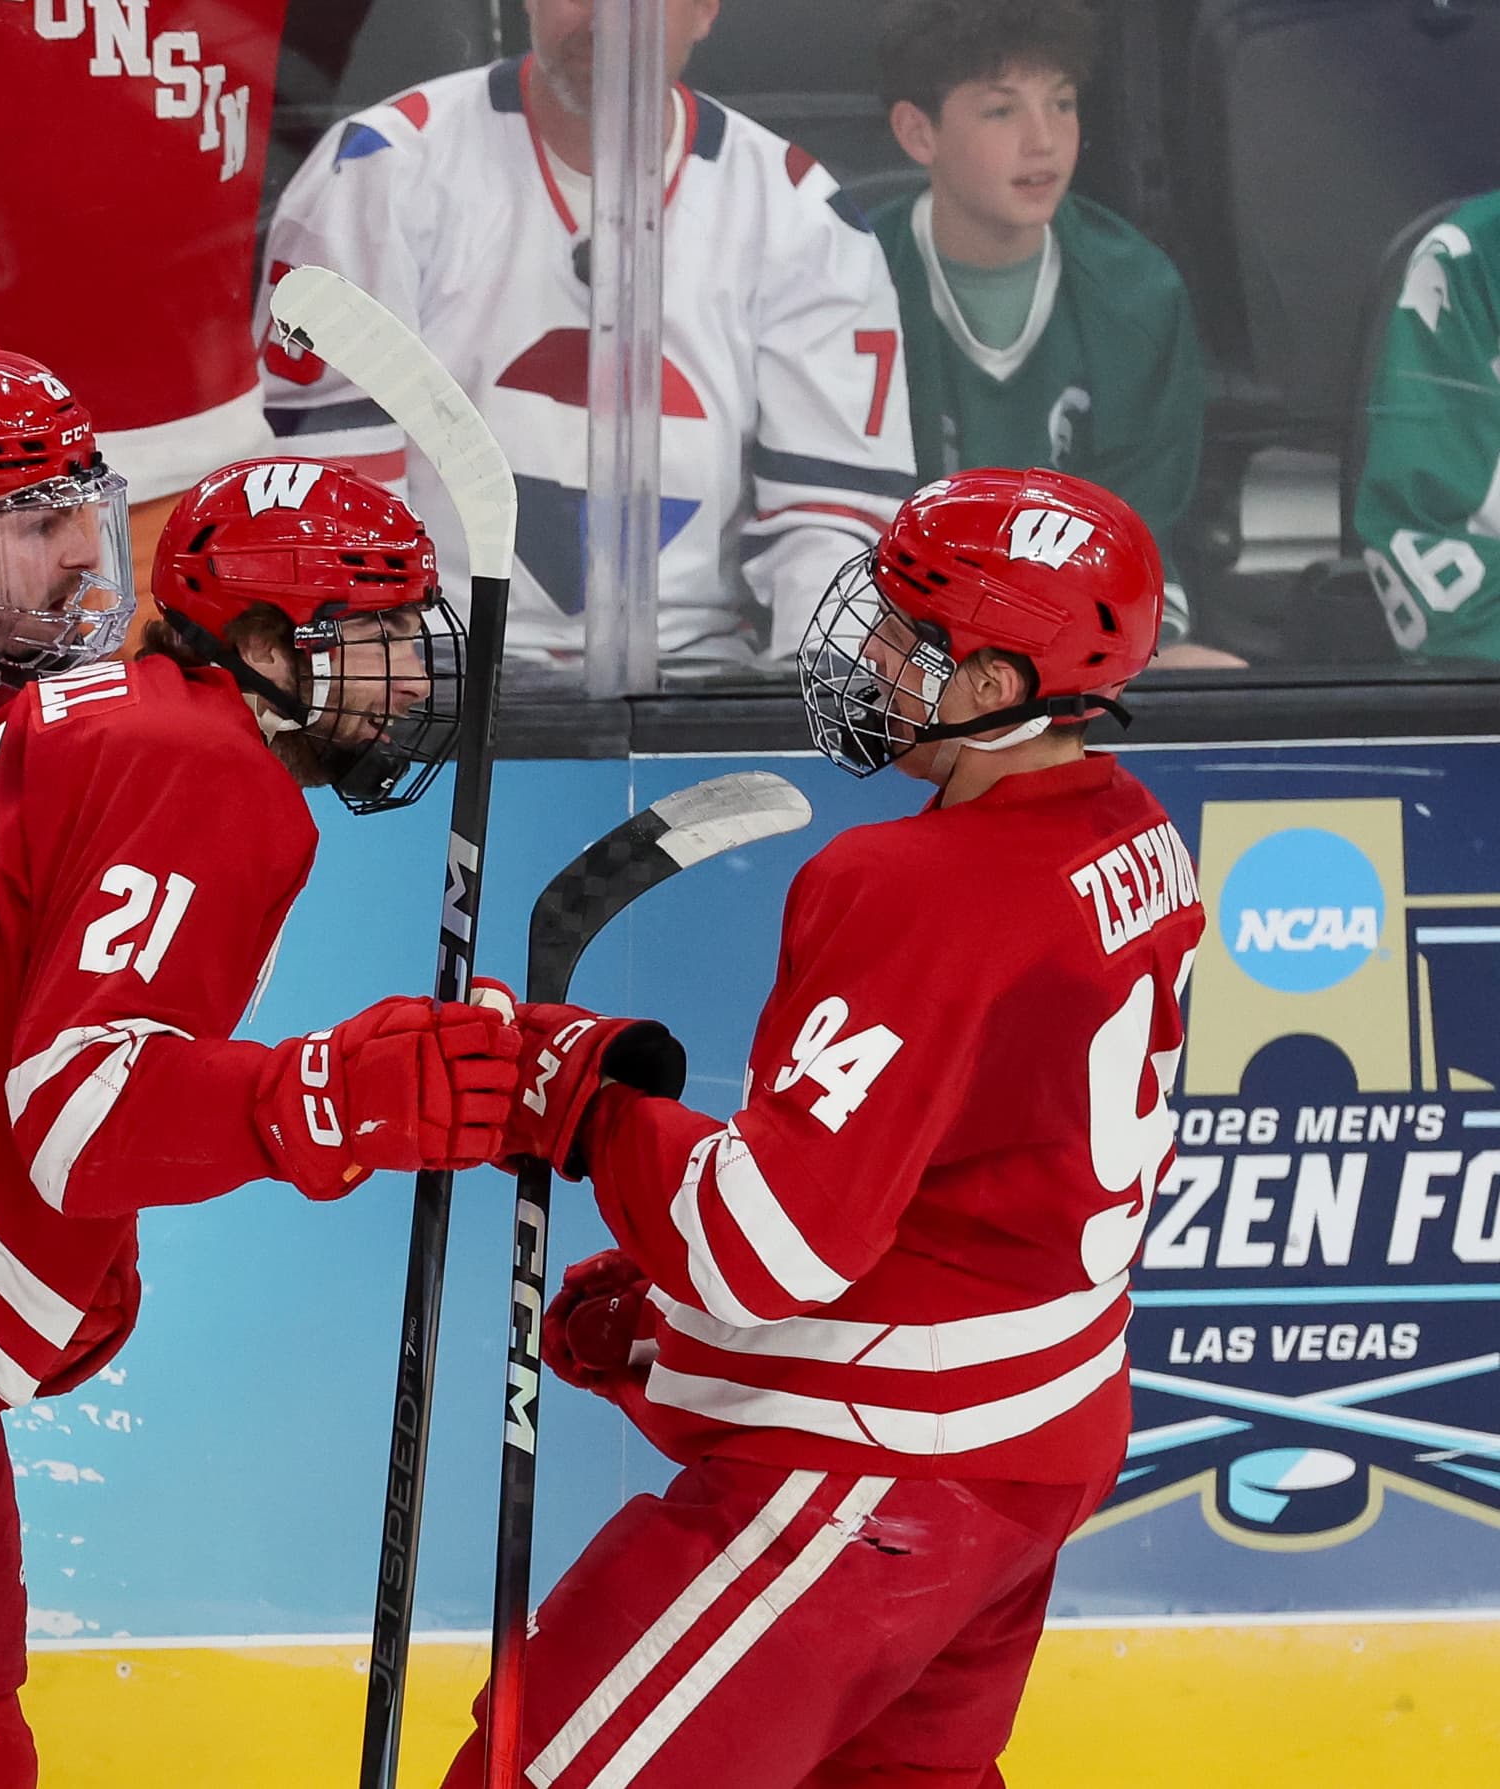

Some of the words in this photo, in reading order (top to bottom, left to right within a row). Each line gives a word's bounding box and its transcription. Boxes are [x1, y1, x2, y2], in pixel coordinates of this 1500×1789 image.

[854, 329, 897, 437] 7
[243, 463, 324, 518] W
[1009, 508, 1096, 570] W
[911, 655, 951, 681] CCM
[78, 864, 196, 985] 21
[1235, 906, 1378, 951] NCAA
[773, 995, 904, 1134] 94
[1293, 1103, 1446, 1144] MEN'S
[504, 1198, 546, 1456] CCM
[1168, 1326, 1257, 1364] LAS
[1271, 1322, 1421, 1363] VEGAS
[371, 1393, 418, 1708] JETSPEED
